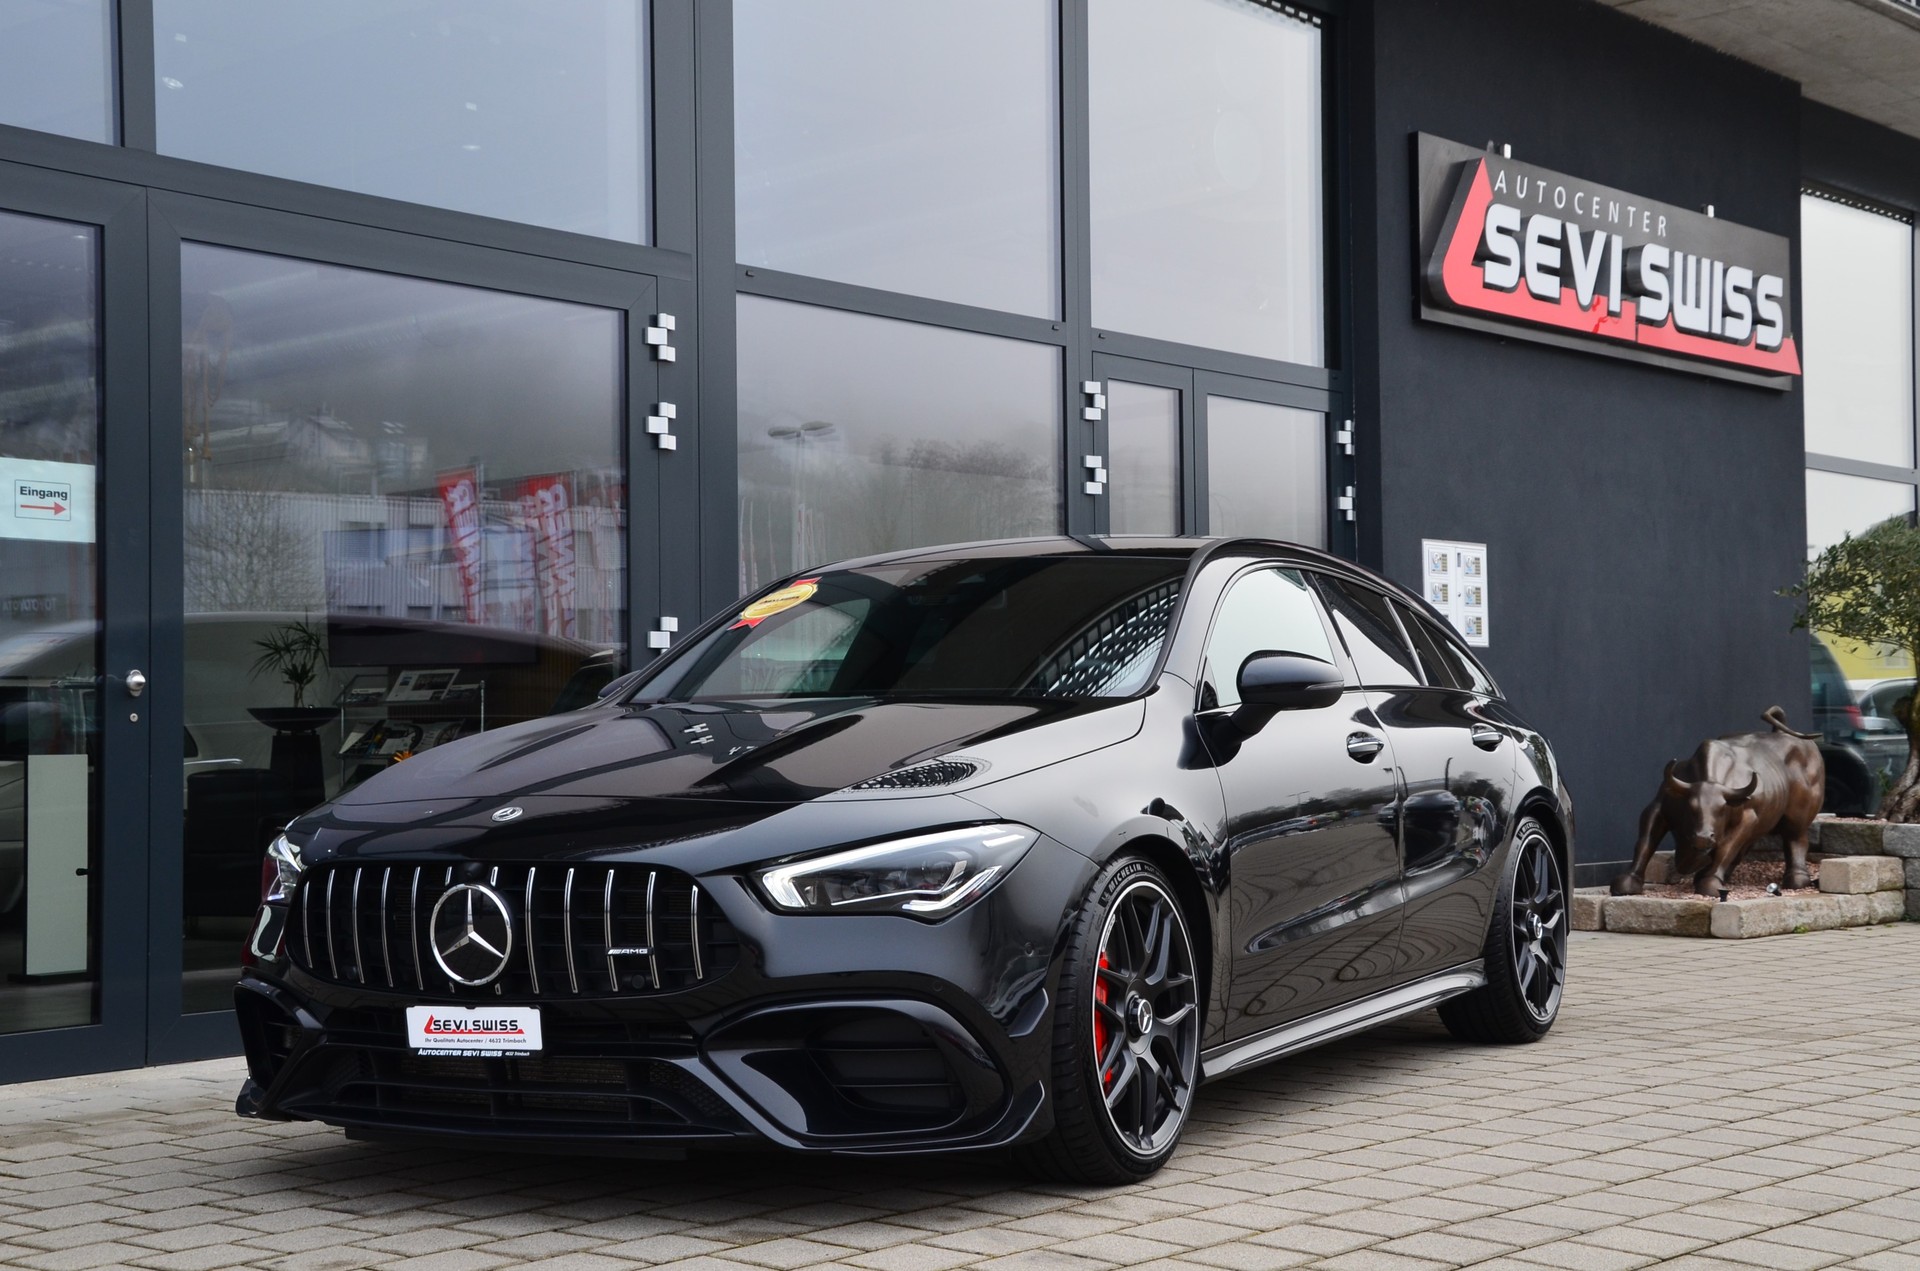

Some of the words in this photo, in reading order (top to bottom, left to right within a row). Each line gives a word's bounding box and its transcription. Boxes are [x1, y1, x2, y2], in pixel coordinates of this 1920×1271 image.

[1494, 169, 1668, 238] AUTOCENTER
[1483, 203, 1623, 315] SEVI
[1639, 242, 1784, 348] SWISS
[20, 485, 68, 501] Eingang
[1108, 863, 1142, 893] MICHELIN
[433, 1020, 467, 1031] SEVI
[472, 1020, 518, 1031] SWISS
